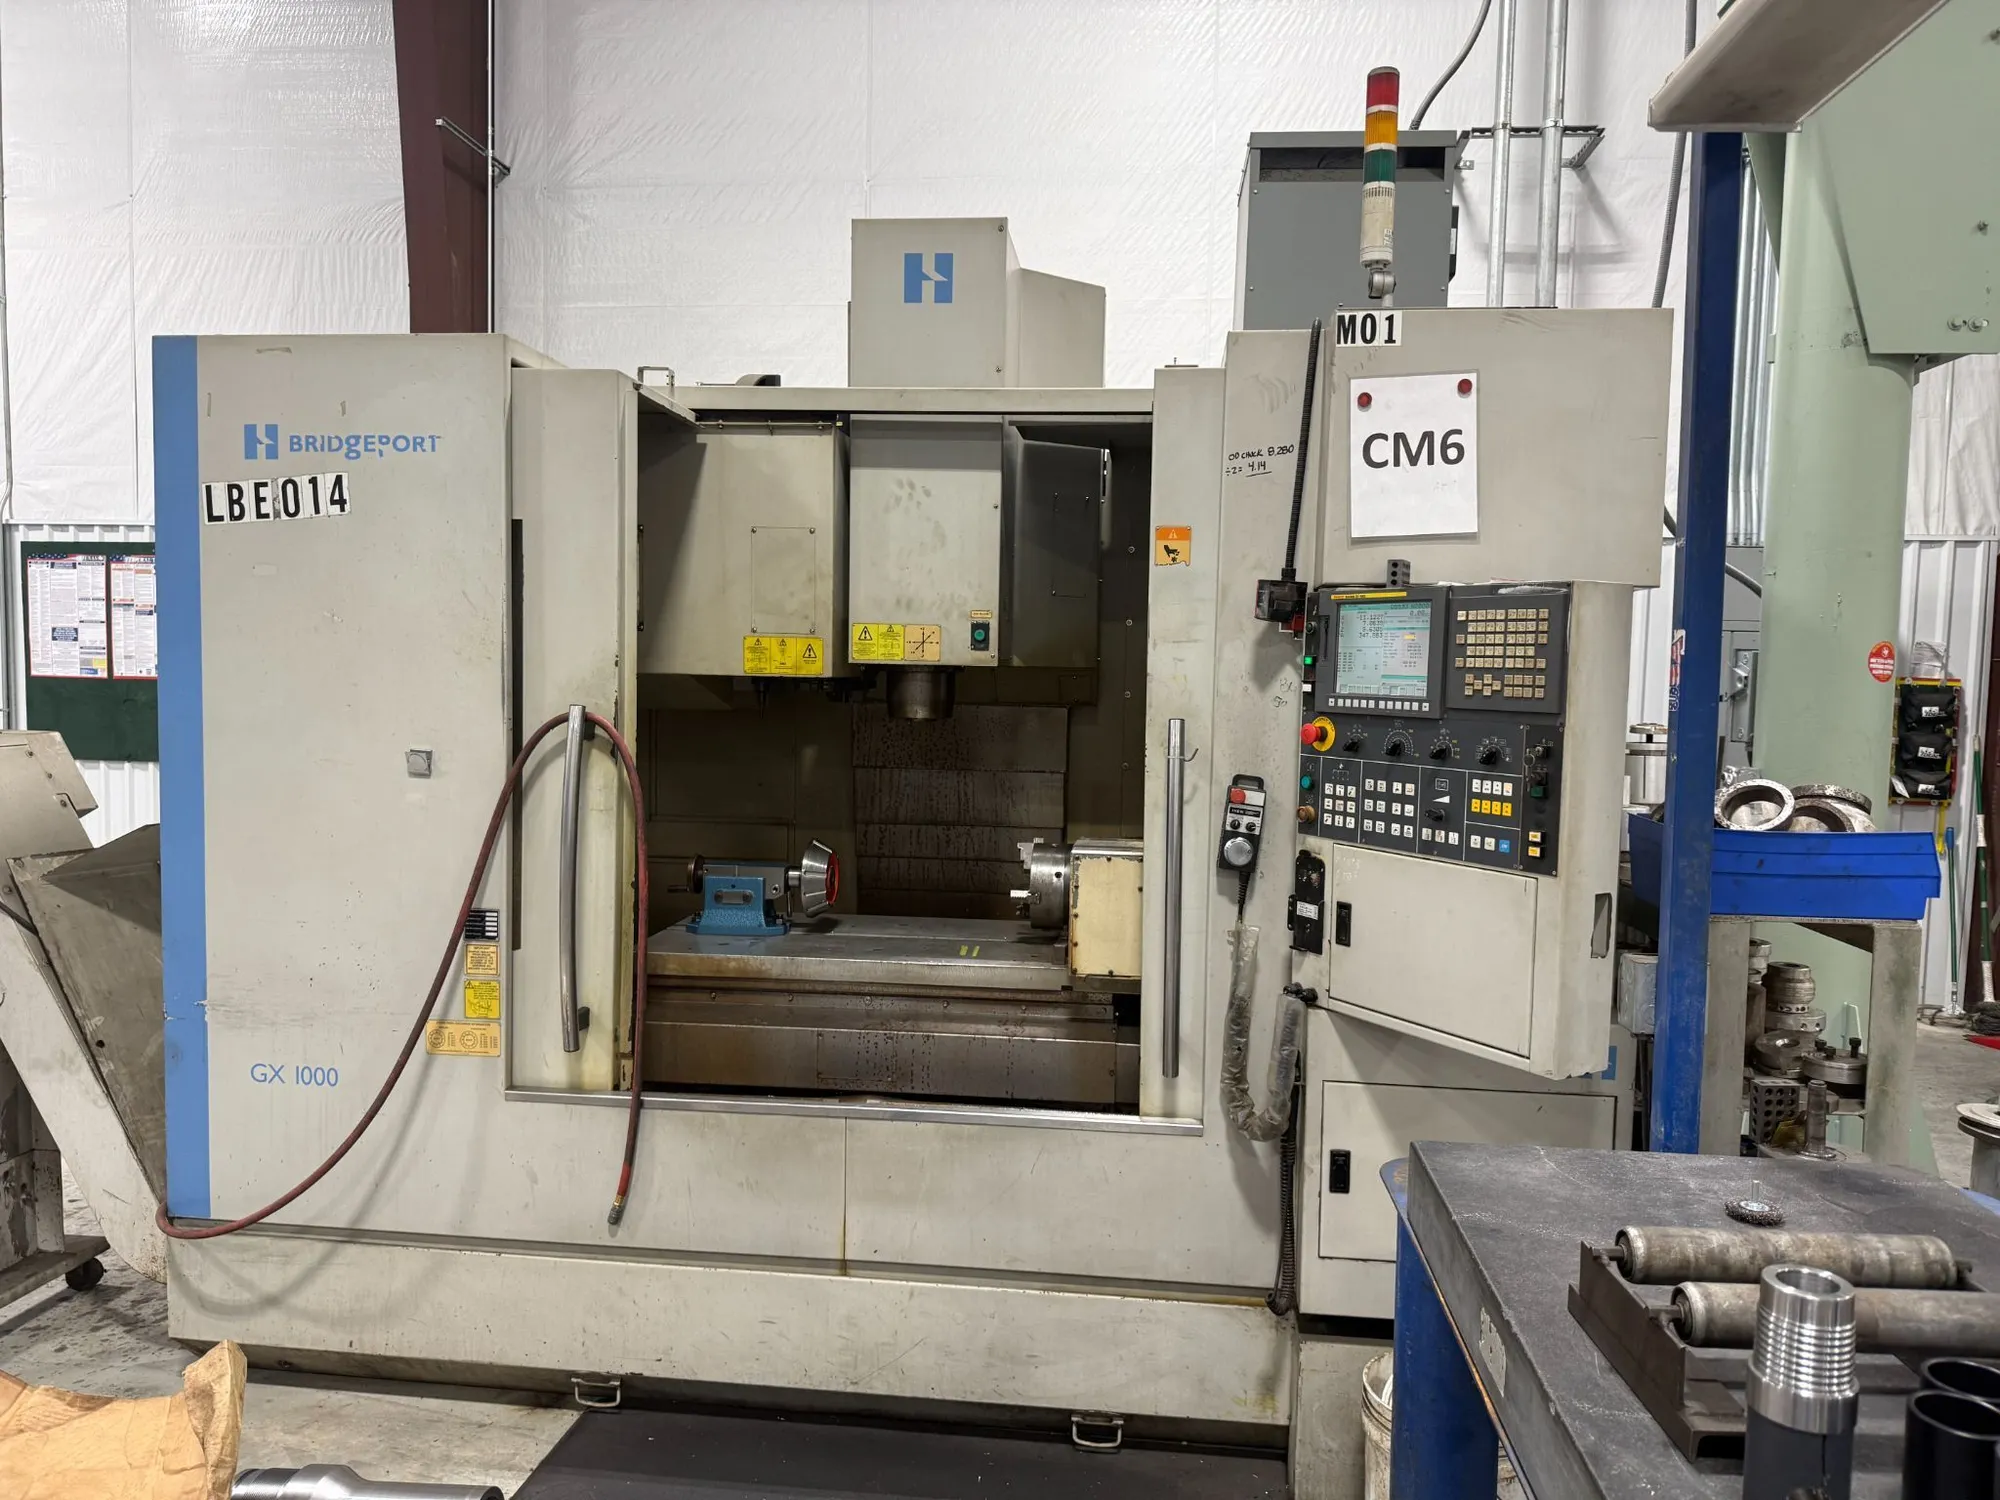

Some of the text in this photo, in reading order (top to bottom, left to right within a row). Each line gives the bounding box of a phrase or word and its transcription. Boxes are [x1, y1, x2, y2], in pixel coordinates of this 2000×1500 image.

[1337, 313, 1396, 344] M01
[1362, 429, 1465, 469] CM6
[1248, 461, 1266, 471] 4.14
[205, 474, 347, 523] LBE014
[251, 1063, 338, 1087] GX 1000
